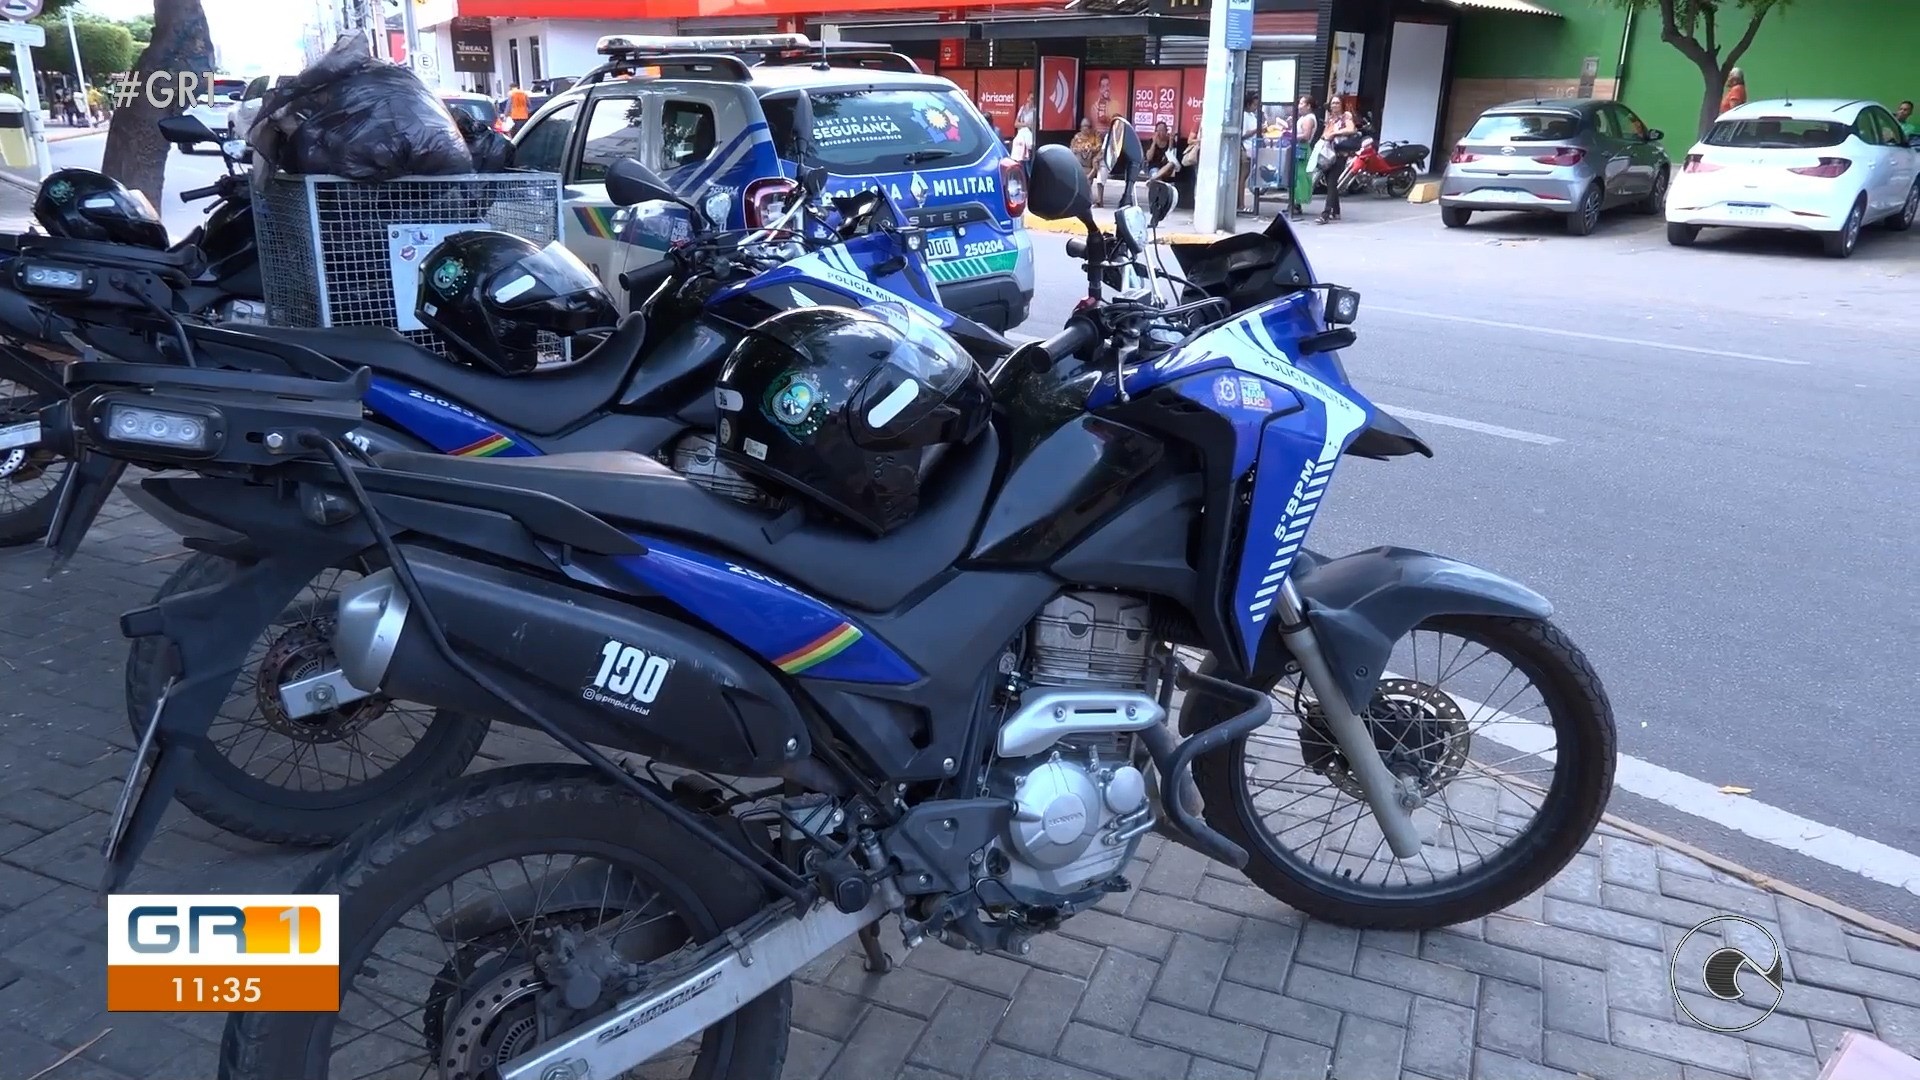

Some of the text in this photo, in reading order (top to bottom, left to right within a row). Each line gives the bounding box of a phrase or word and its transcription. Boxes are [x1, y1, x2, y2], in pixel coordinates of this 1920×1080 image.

[422, 56, 429, 66] E
[985, 92, 1014, 103] brisanet
[1136, 88, 1175, 102] 500 20
[1135, 100, 1153, 108] MEGA
[815, 116, 857, 127] UNTOS
[812, 122, 901, 140] SEGURANÇA
[820, 138, 851, 147] GOVERNO
[861, 134, 902, 142] PERNAMBUCO
[933, 176, 996, 197] MILITAR
[909, 210, 969, 226] STER
[964, 239, 1004, 257] 250204
[726, 562, 833, 610] 250
[594, 640, 669, 703] 190
